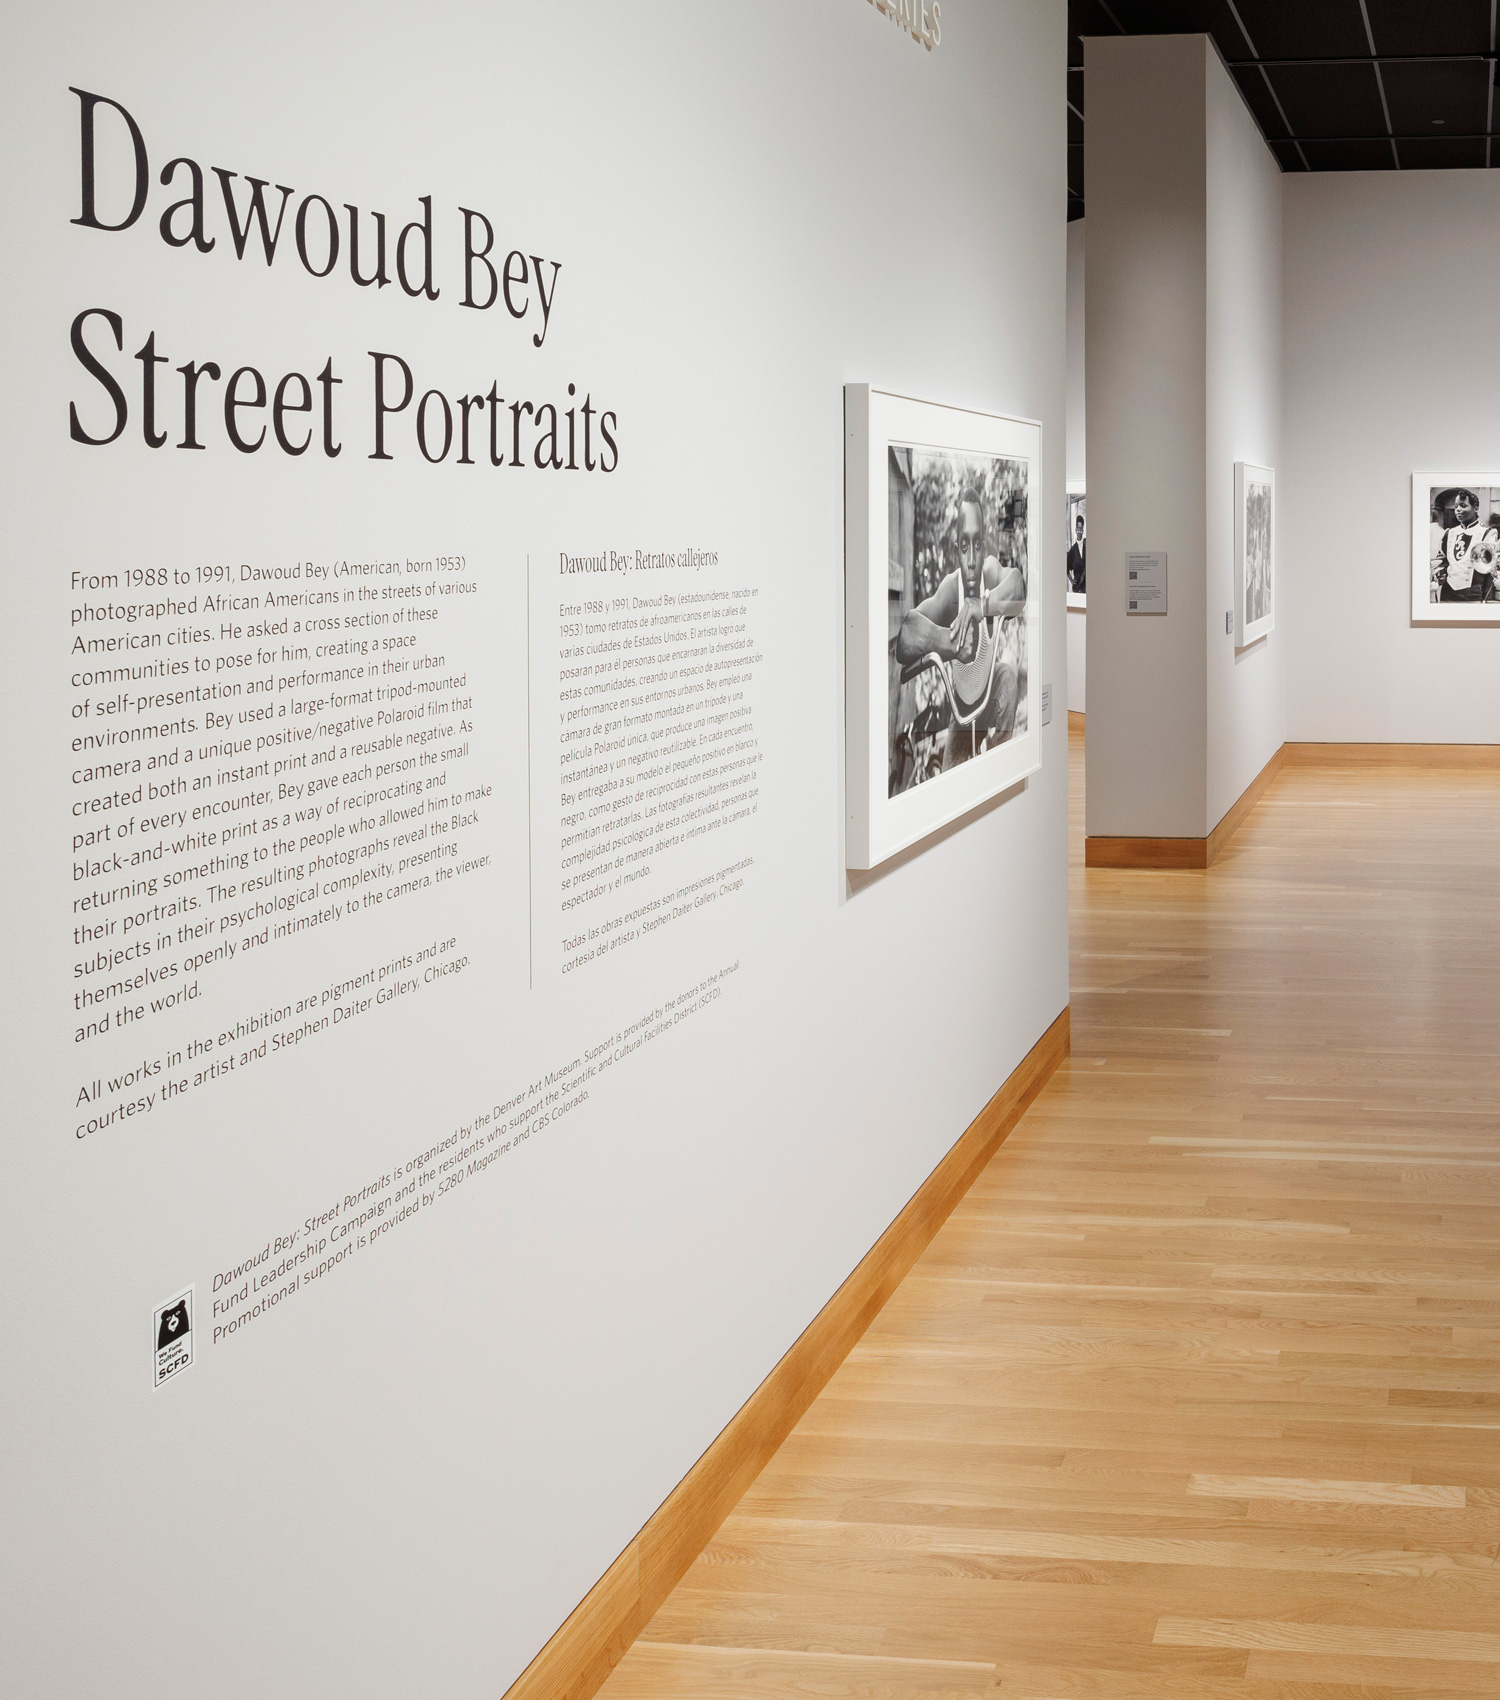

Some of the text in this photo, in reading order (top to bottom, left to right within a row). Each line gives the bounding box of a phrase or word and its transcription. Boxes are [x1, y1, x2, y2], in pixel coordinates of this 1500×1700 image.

[69, 86, 562, 348] Dawoud Bey
[69, 307, 619, 473] Street Portraits
[71, 555, 466, 590] From 1988 to 1991, Dawoud Bey (American, born 1953)
[559, 547, 719, 576] Dawoud Bey: Retratos callejeros
[70, 606, 439, 655] American cities. He asked a cross section of these
[71, 580, 477, 627] photographed African Americans in the streets of various
[559, 603, 582, 617] Entre
[582, 600, 604, 614] 1988
[604, 603, 610, 615] y
[611, 597, 631, 611] 1991,
[632, 594, 663, 609] Dawoud
[663, 594, 677, 607] Bey
[731, 586, 751, 599] nacido
[751, 588, 759, 597] en
[71, 635, 417, 687] communities to pose for him, creating a space
[71, 653, 445, 719] of self-presentation and performance in their urban
[71, 672, 466, 752] environments. Bey used a large-format tripod-mounted
[71, 695, 473, 784] camera and a unique positive/negative Polaroid film that
[72, 719, 473, 817] created both an instant print and a reusable negative. As
[72, 741, 469, 854] part of every encounter, Bey gave each person the small
[561, 864, 652, 911] espectador y el mundo.
[596, 939, 609, 957] del
[609, 930, 635, 950] artista
[635, 927, 641, 940] y
[642, 913, 671, 934] Stephen
[672, 902, 693, 920] Daiter
[718, 878, 745, 896] Chicago.
[75, 937, 457, 1108] All works in the exhibition are pigment prints and are
[75, 956, 471, 1139] courtesy the artist and Stephen Daiter Gallery, Chicago.
[213, 1089, 590, 1345] Promotional support is provided by 5280 Magazine and CBS Colorado.
[158, 1341, 182, 1359] We Fund
[159, 1348, 184, 1365] Culture.
[159, 1353, 189, 1379] SCFD
